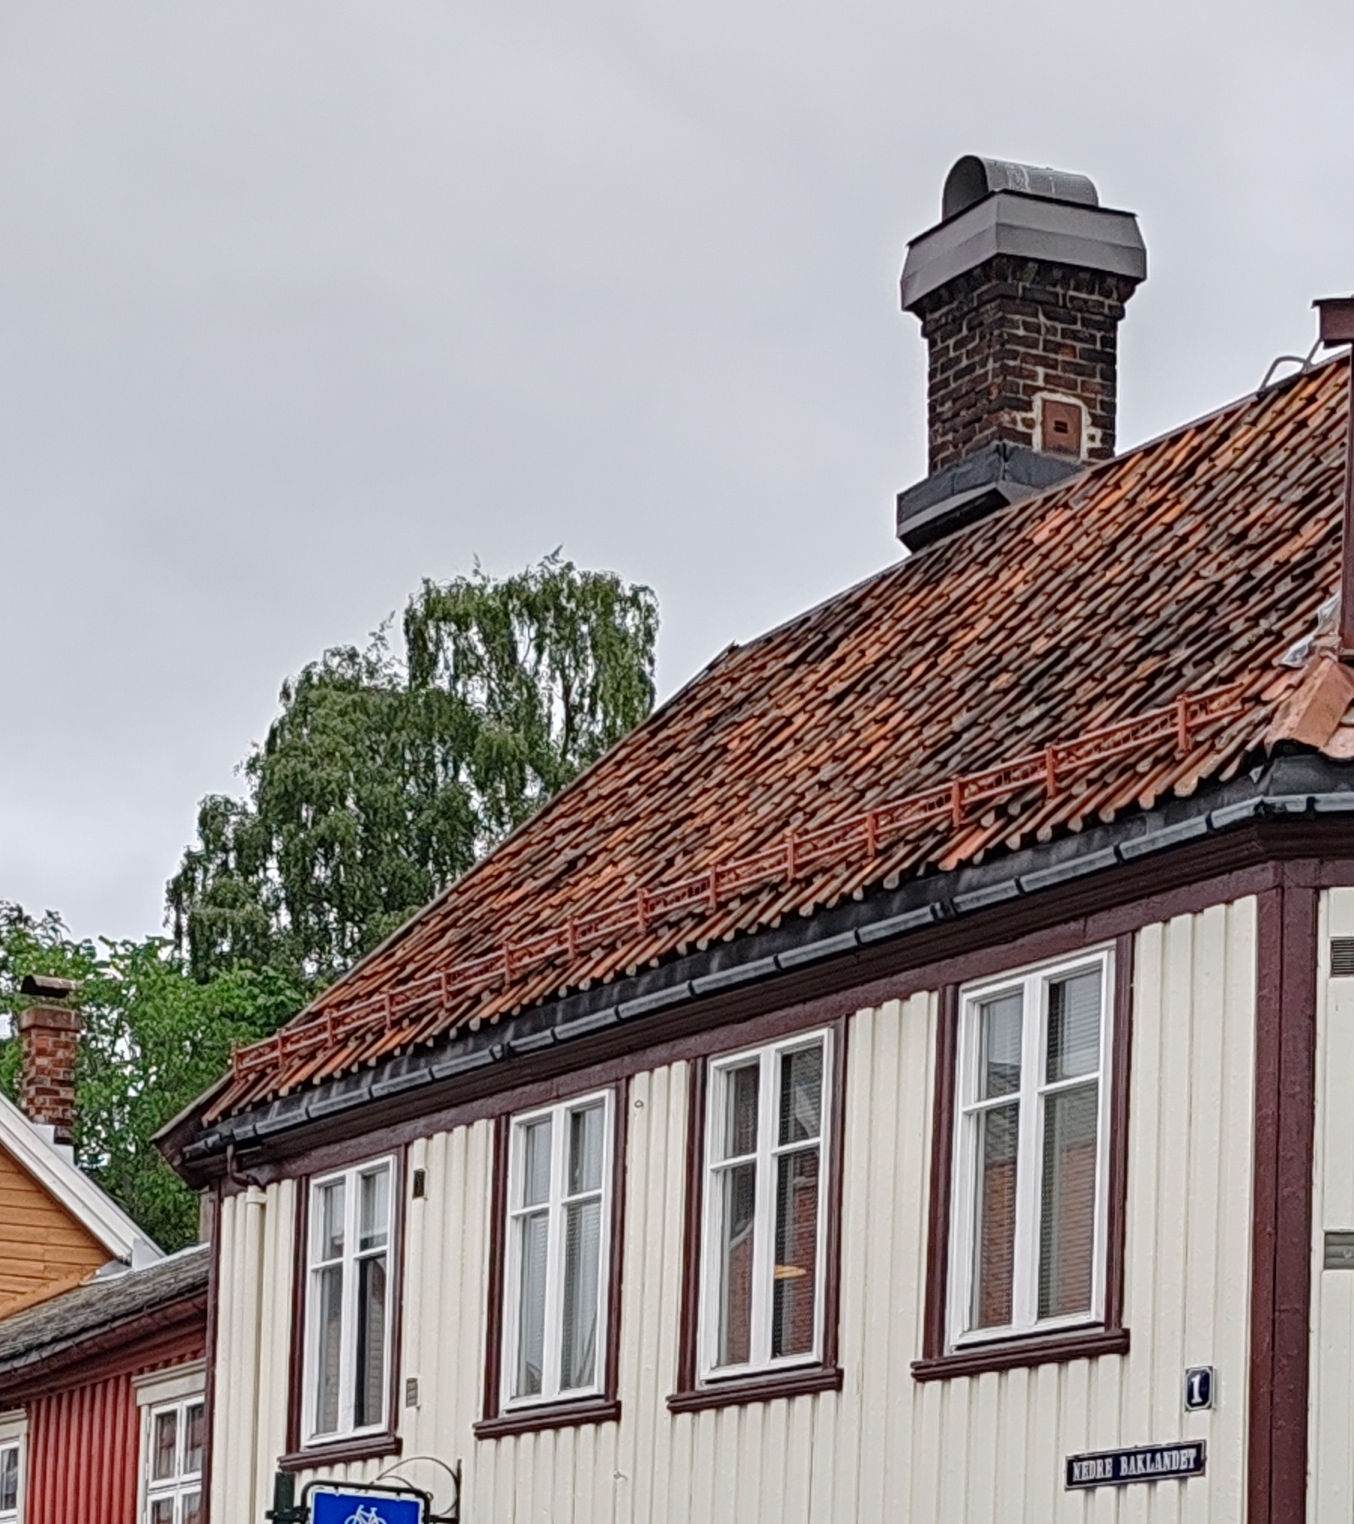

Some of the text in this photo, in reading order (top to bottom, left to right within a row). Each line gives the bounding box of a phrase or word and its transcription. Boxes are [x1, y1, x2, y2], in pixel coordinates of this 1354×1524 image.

[1190, 1373, 1203, 1404] 1
[1072, 1448, 1197, 1482] NEDRE BAKLANDET
